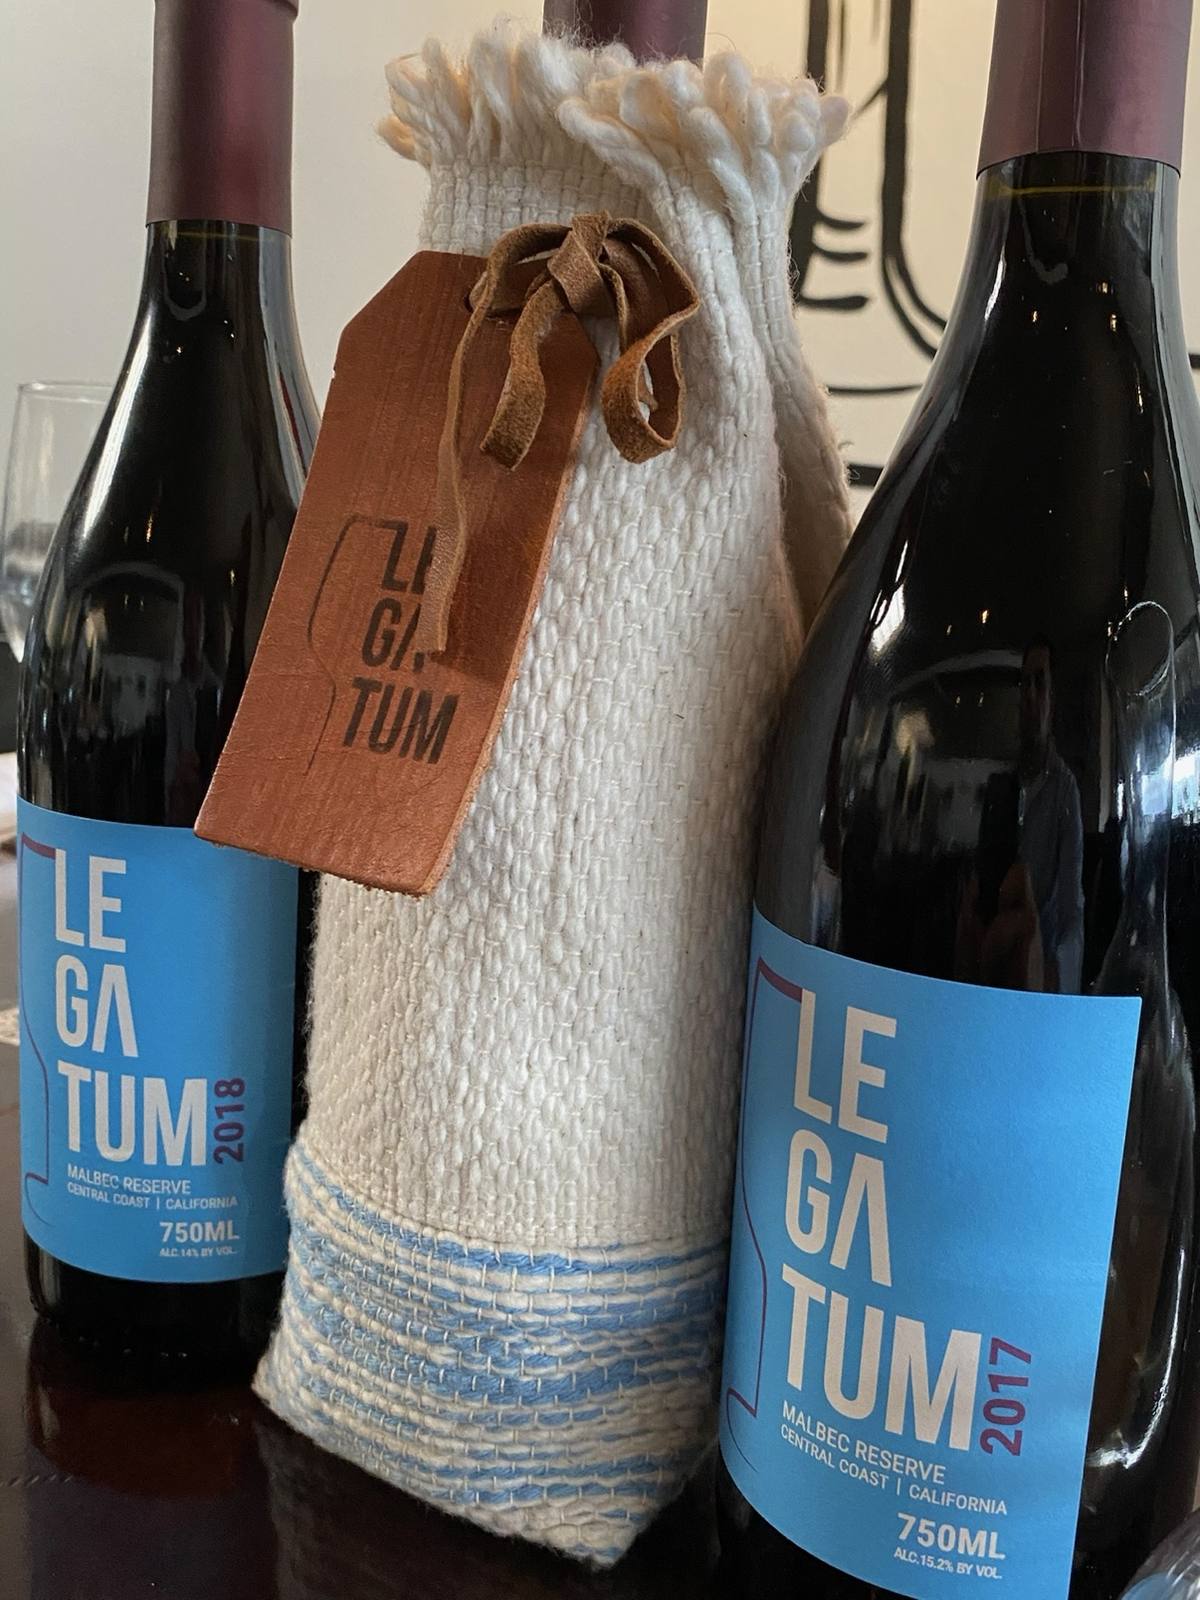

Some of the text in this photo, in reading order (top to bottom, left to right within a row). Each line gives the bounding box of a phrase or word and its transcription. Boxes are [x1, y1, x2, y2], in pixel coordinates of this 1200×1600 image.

[342, 676, 460, 765] TUM
[54, 847, 127, 953] LE
[55, 954, 139, 1058] GA
[794, 987, 898, 1145] LE
[57, 1059, 208, 1167] TUM
[213, 1077, 246, 1165] 2018
[67, 1163, 191, 1194] MALBEC RESERVE
[67, 1182, 238, 1210] CENTRAL COAST CALIFORNIA
[785, 1128, 893, 1288] GA
[159, 1219, 240, 1243] 750ML
[201, 1247, 214, 1257] BY
[782, 1263, 983, 1452] TUM
[979, 1336, 1033, 1457] 2017
[781, 1423, 1008, 1516] CENTRAL COAST CALIFORNIA
[782, 1400, 946, 1485] MALBEC RESERVE
[897, 1511, 1006, 1560] 750ML
[956, 1562, 974, 1576] BY
